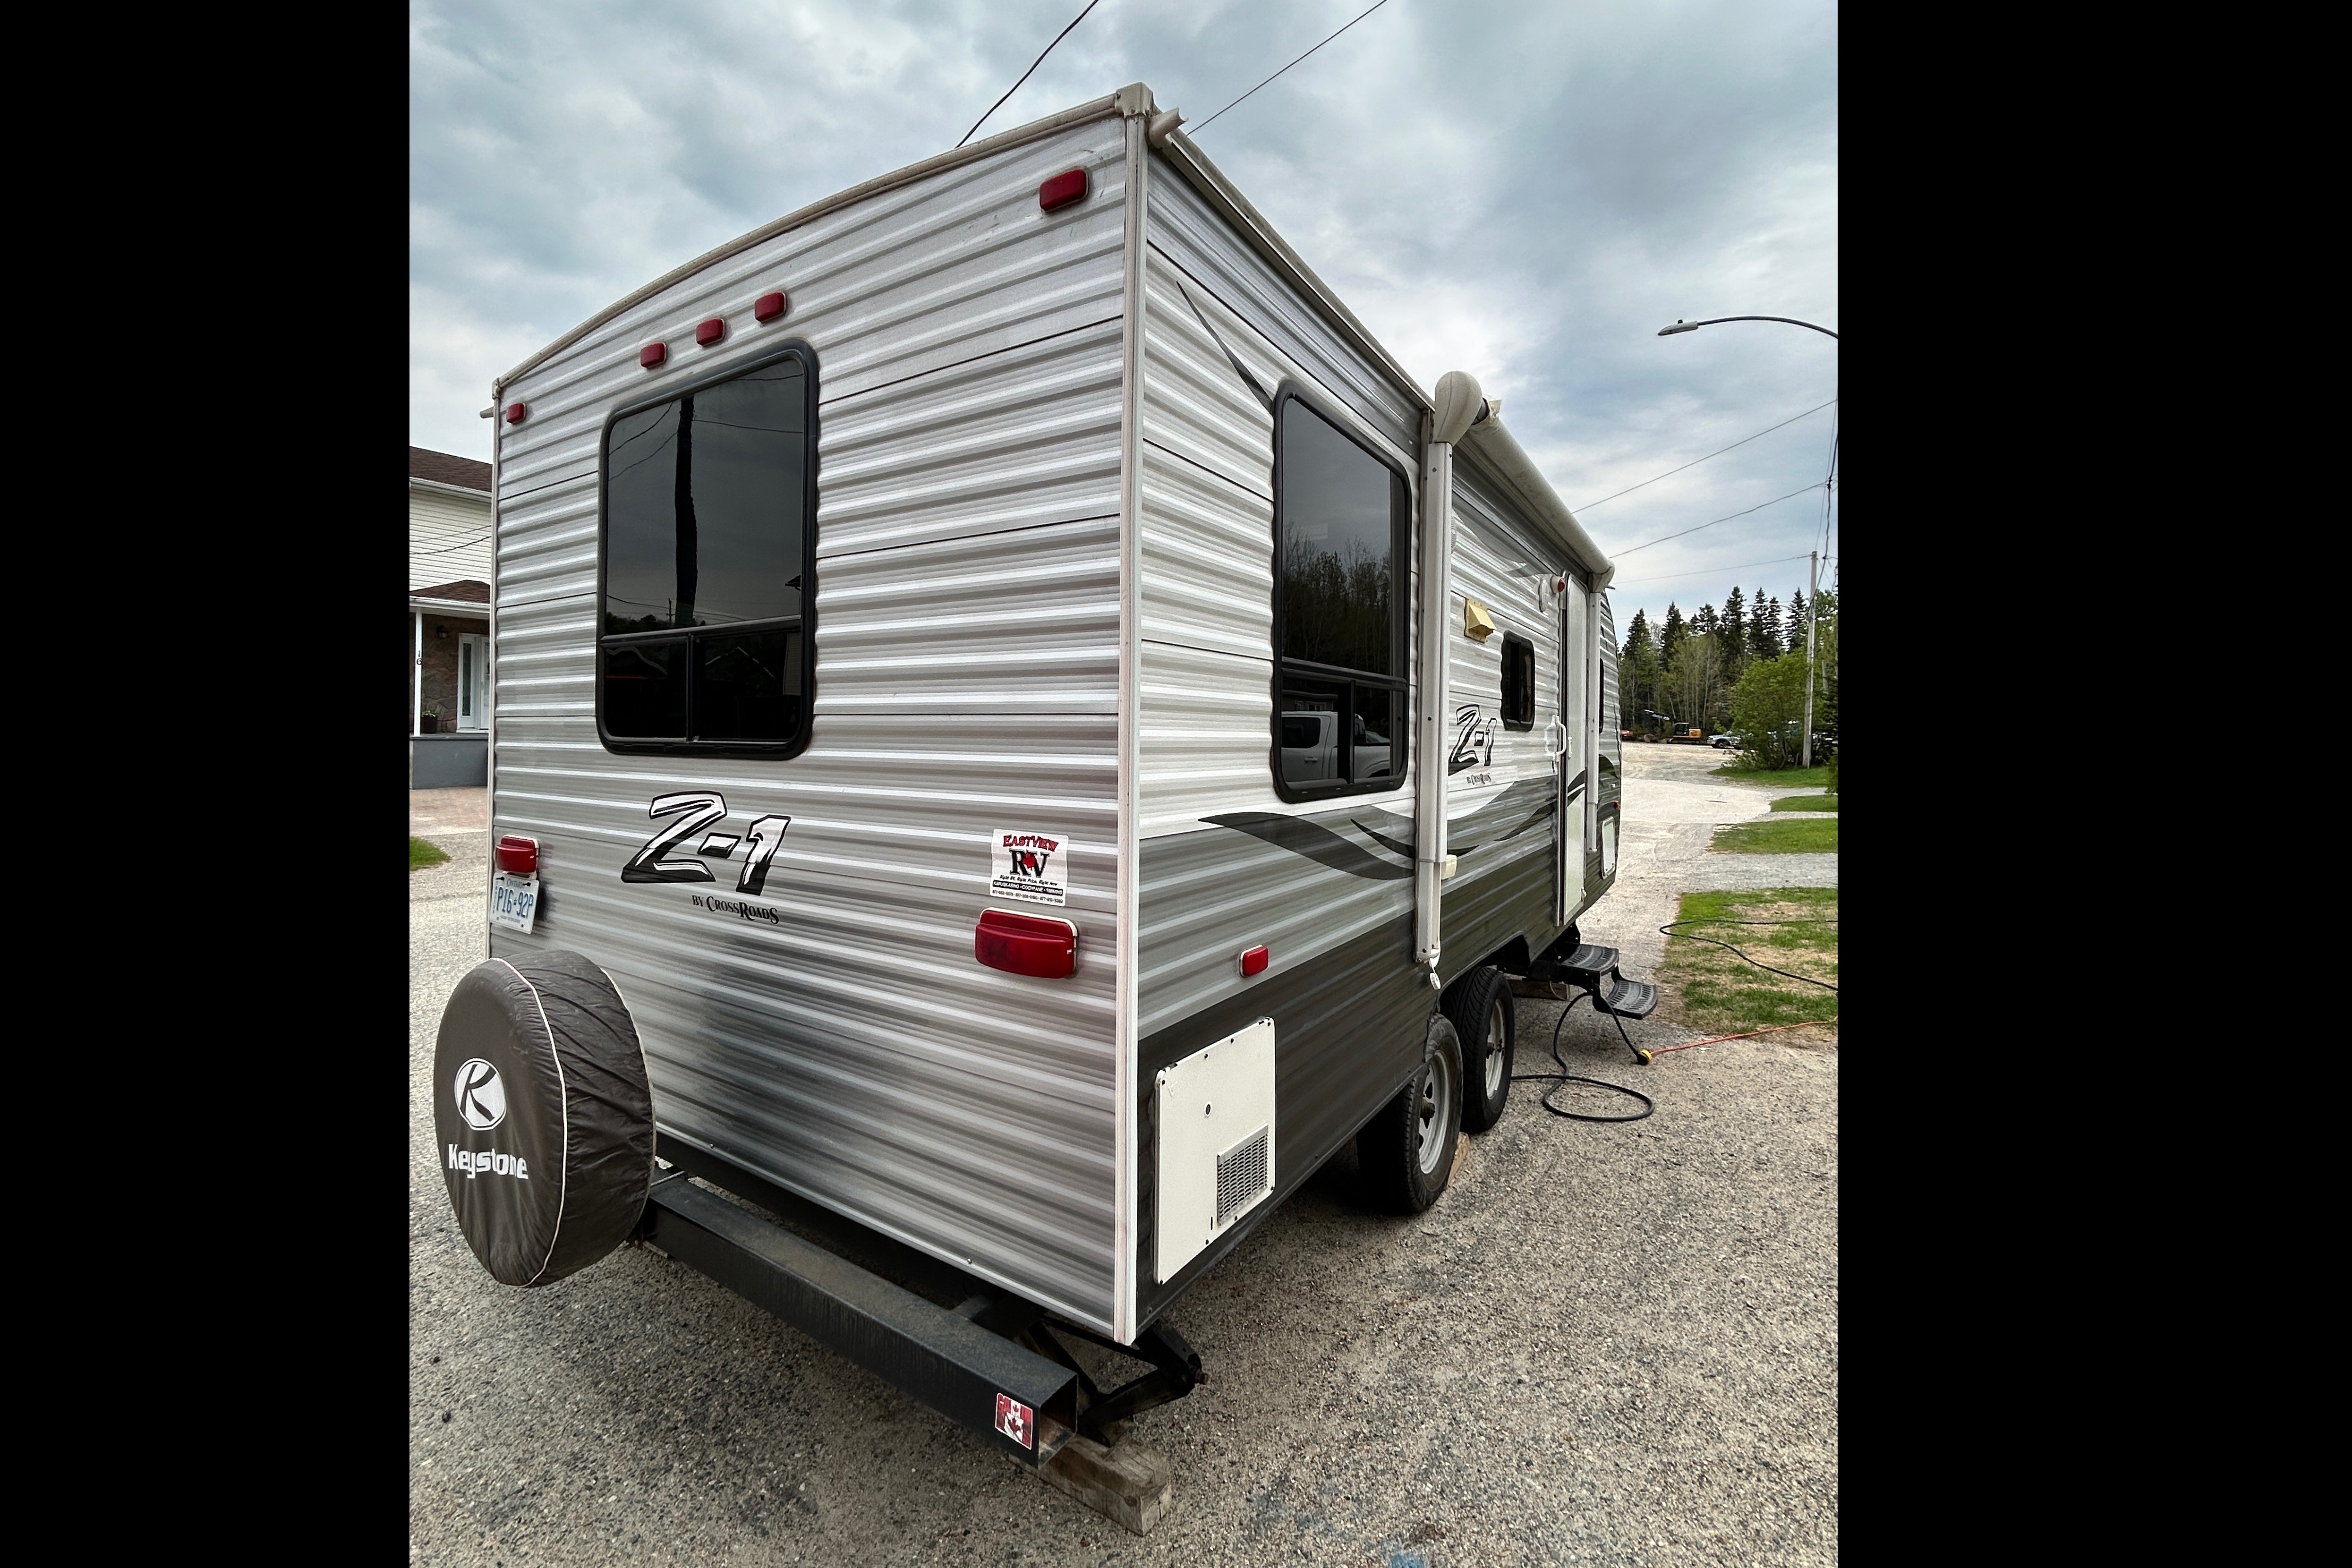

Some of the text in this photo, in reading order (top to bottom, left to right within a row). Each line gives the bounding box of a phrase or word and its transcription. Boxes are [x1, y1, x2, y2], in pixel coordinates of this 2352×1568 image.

[417, 650, 422, 665] 16
[1003, 834, 1059, 852] EASTVIEW
[1009, 848, 1050, 878] RV
[691, 895, 704, 907] BY
[449, 1143, 528, 1179] Keystone
